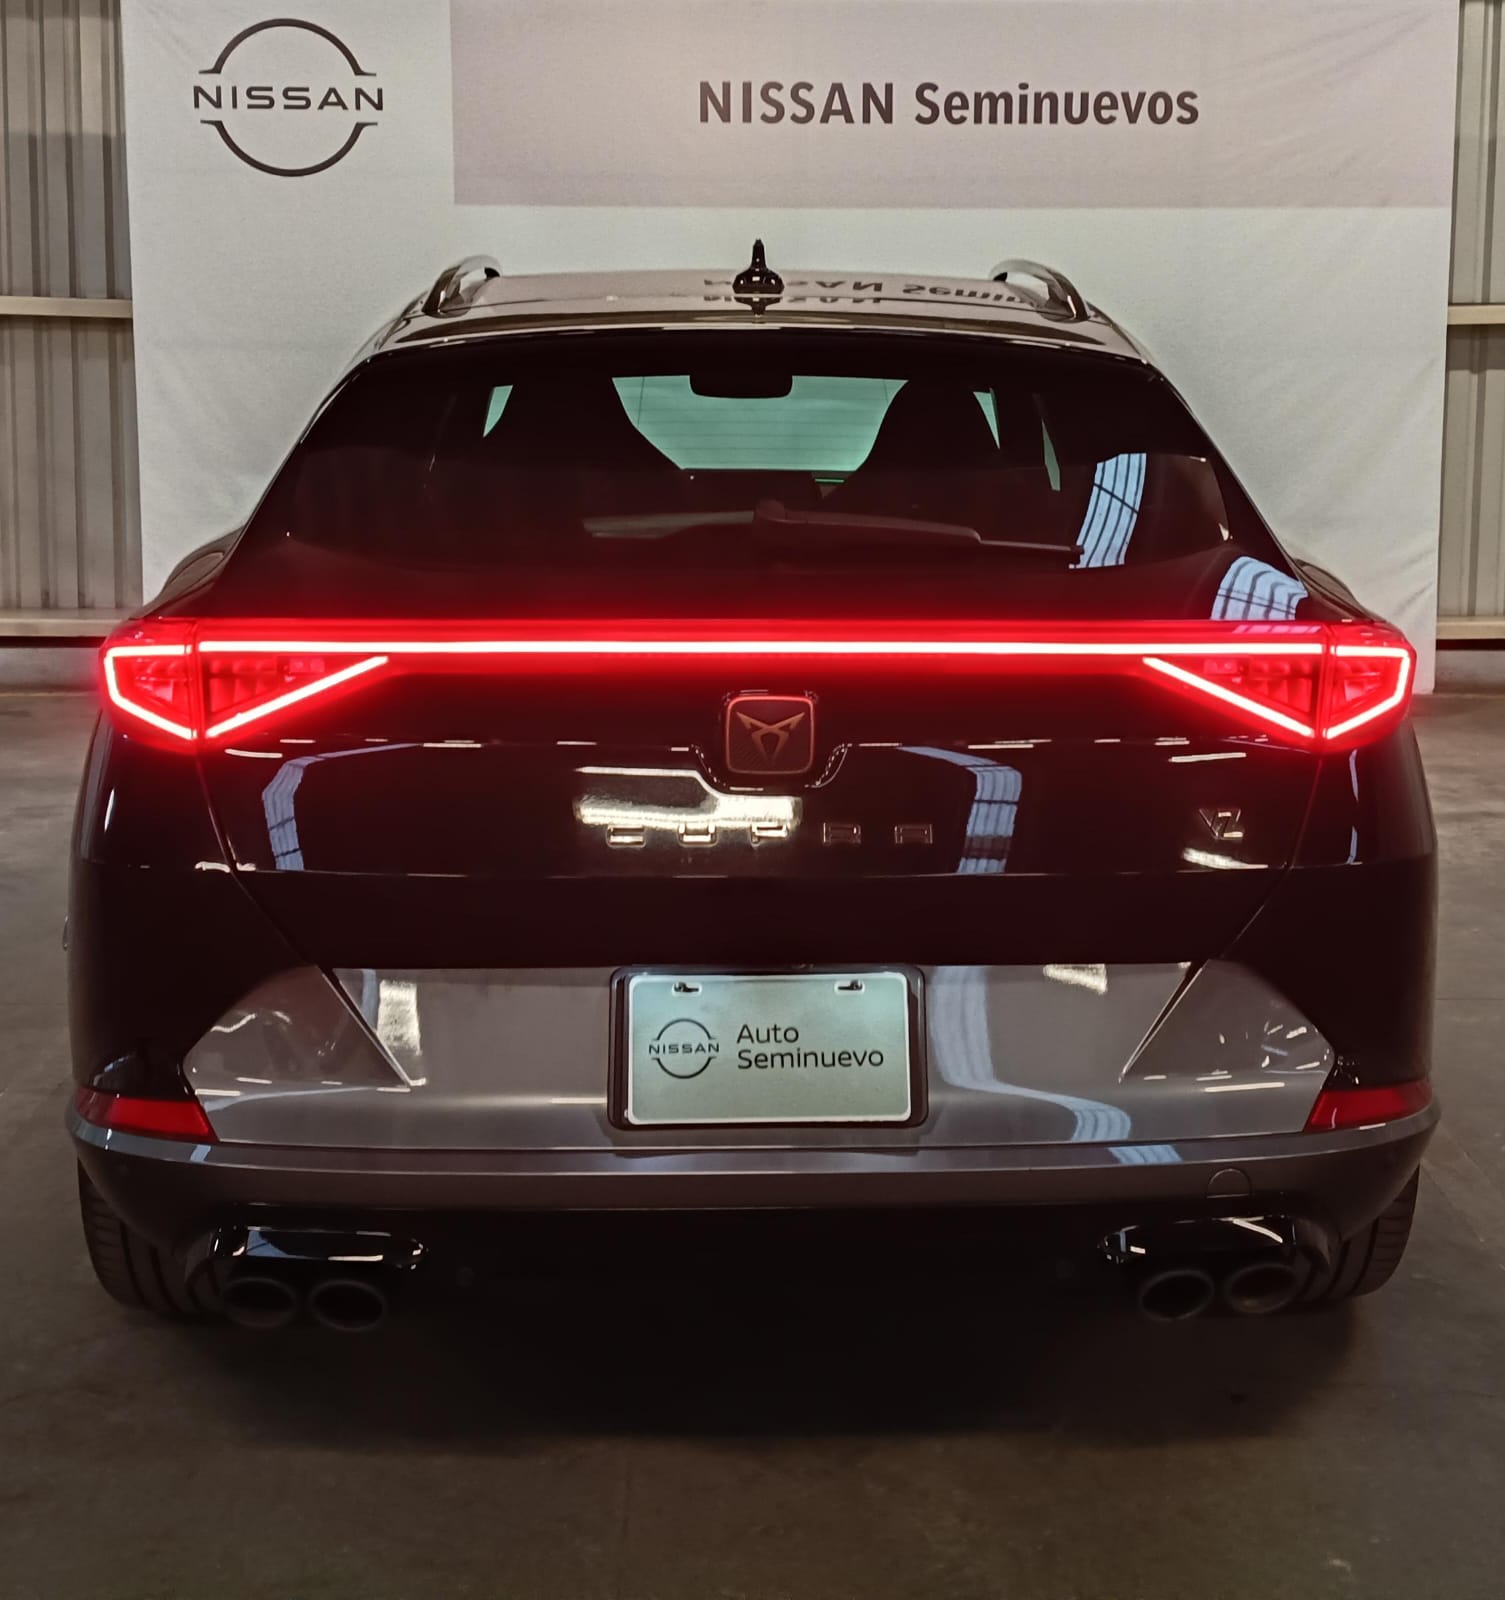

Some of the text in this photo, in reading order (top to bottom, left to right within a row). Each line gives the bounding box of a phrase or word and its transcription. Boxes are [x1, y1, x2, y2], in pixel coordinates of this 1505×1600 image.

[193, 85, 384, 112] NISSAN
[698, 80, 1200, 126] NISSAN Seminuevos
[736, 1023, 800, 1045] Auto
[648, 1042, 720, 1056] NISSAN
[736, 1047, 885, 1071] Seminuevo
